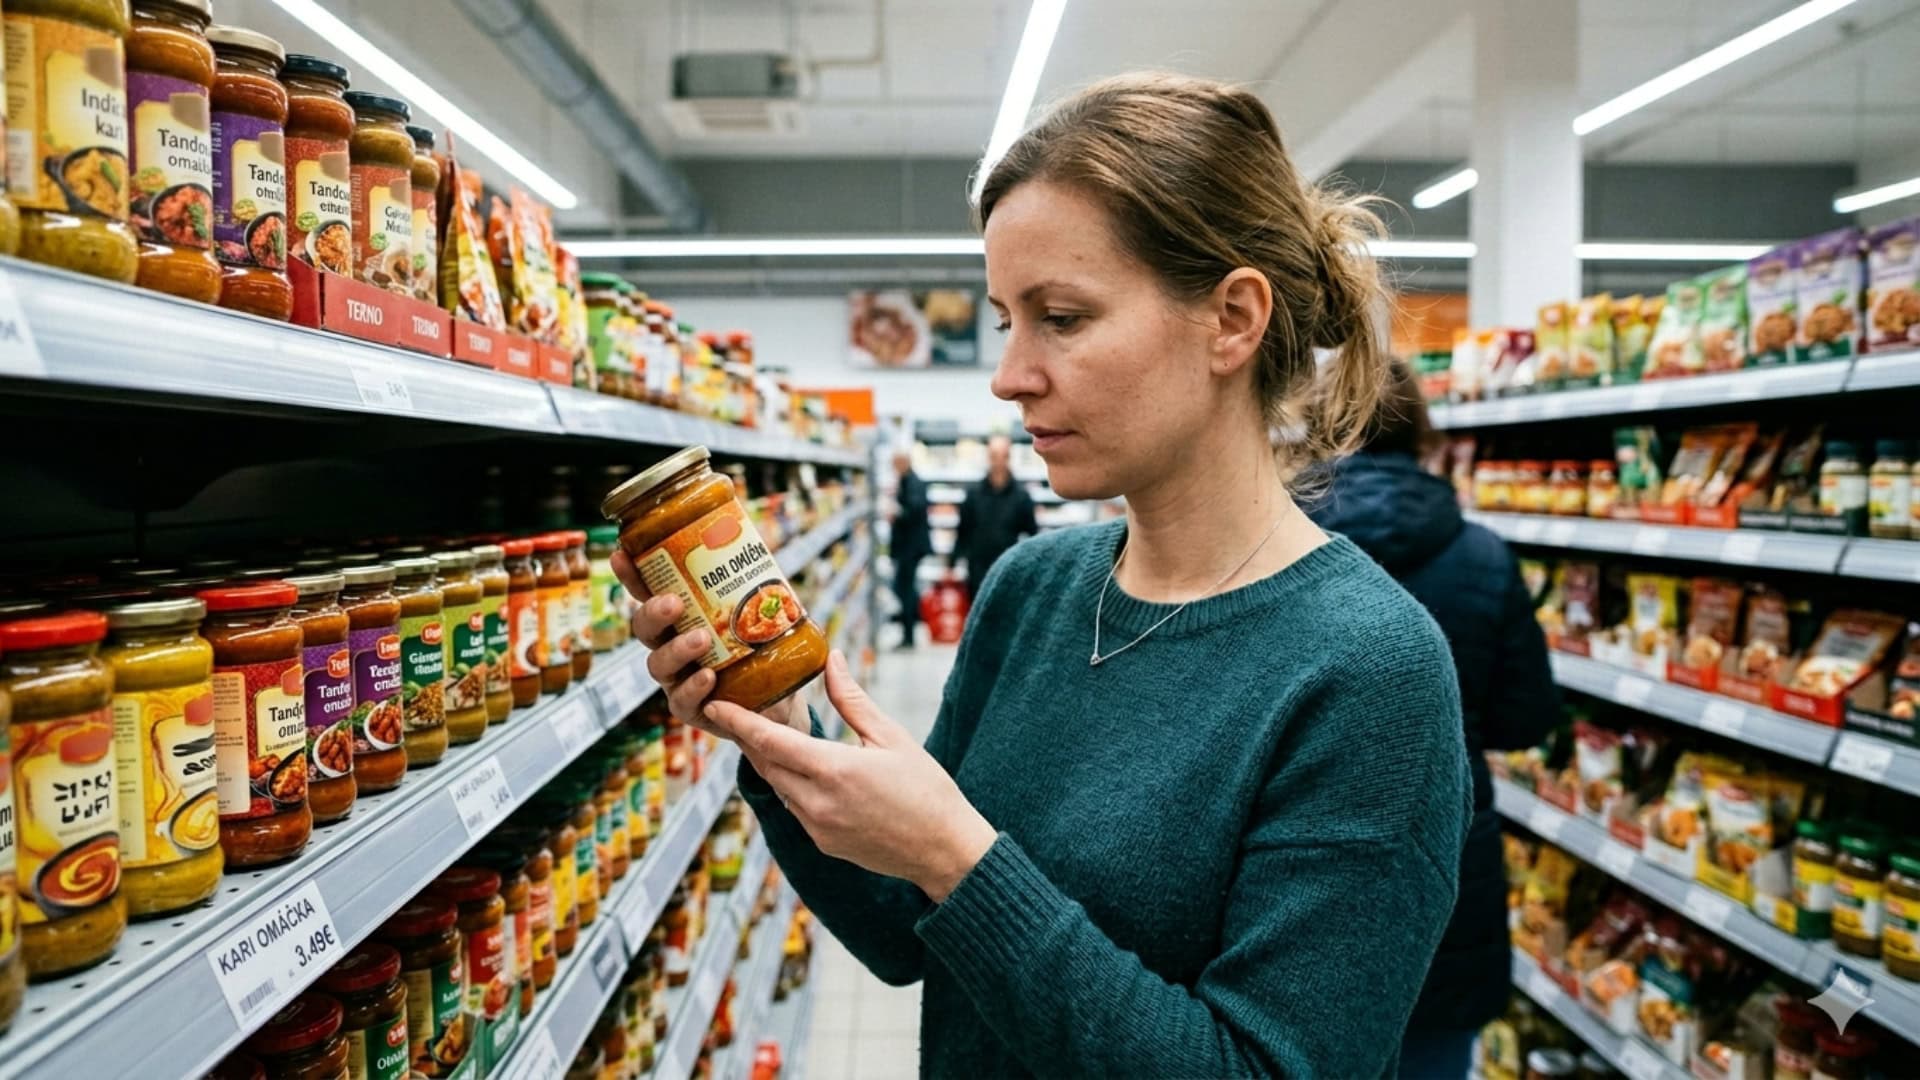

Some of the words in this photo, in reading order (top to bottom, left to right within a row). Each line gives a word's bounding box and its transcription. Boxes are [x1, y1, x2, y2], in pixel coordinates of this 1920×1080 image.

[346, 298, 384, 326] TERNO
[217, 936, 257, 976] KARI
[295, 923, 335, 968] 3.49€
